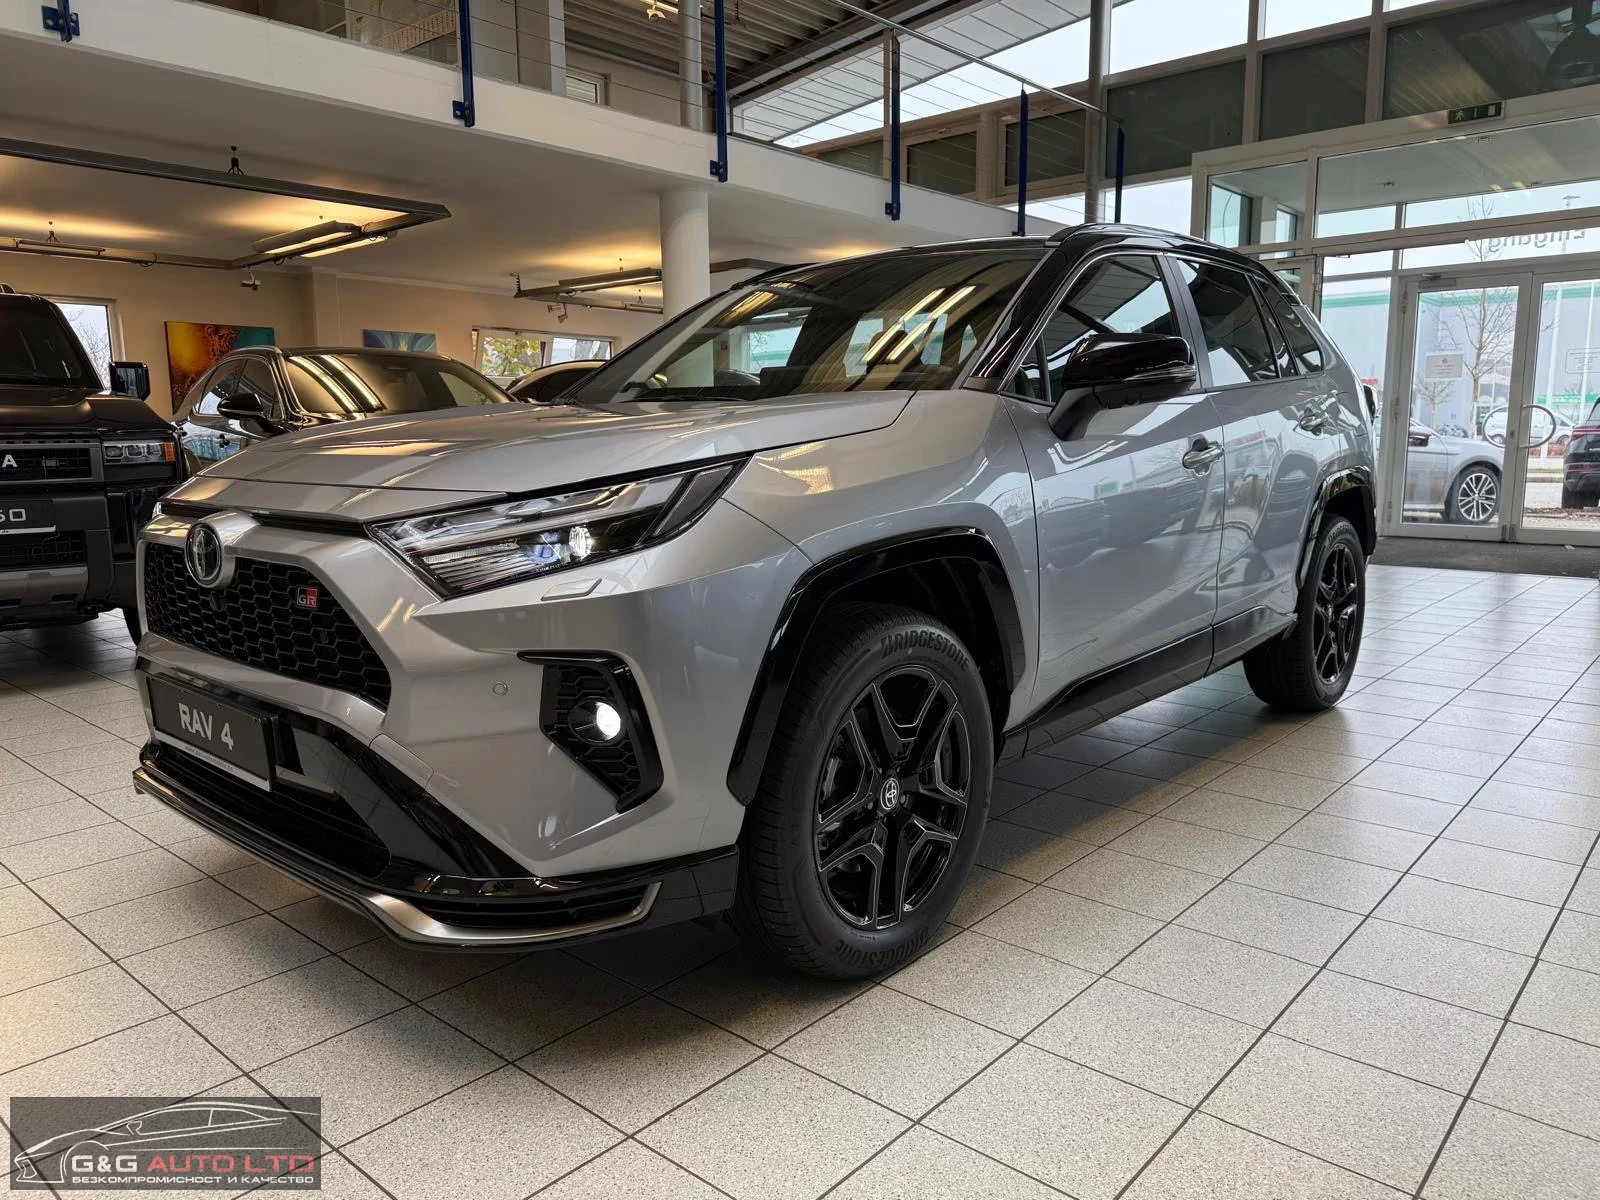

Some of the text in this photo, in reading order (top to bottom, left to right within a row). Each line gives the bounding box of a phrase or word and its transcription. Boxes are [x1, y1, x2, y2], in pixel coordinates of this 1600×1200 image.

[298, 593, 317, 607] GR
[881, 630, 969, 672] BRIDGESTONE
[178, 702, 234, 751] RAV 4
